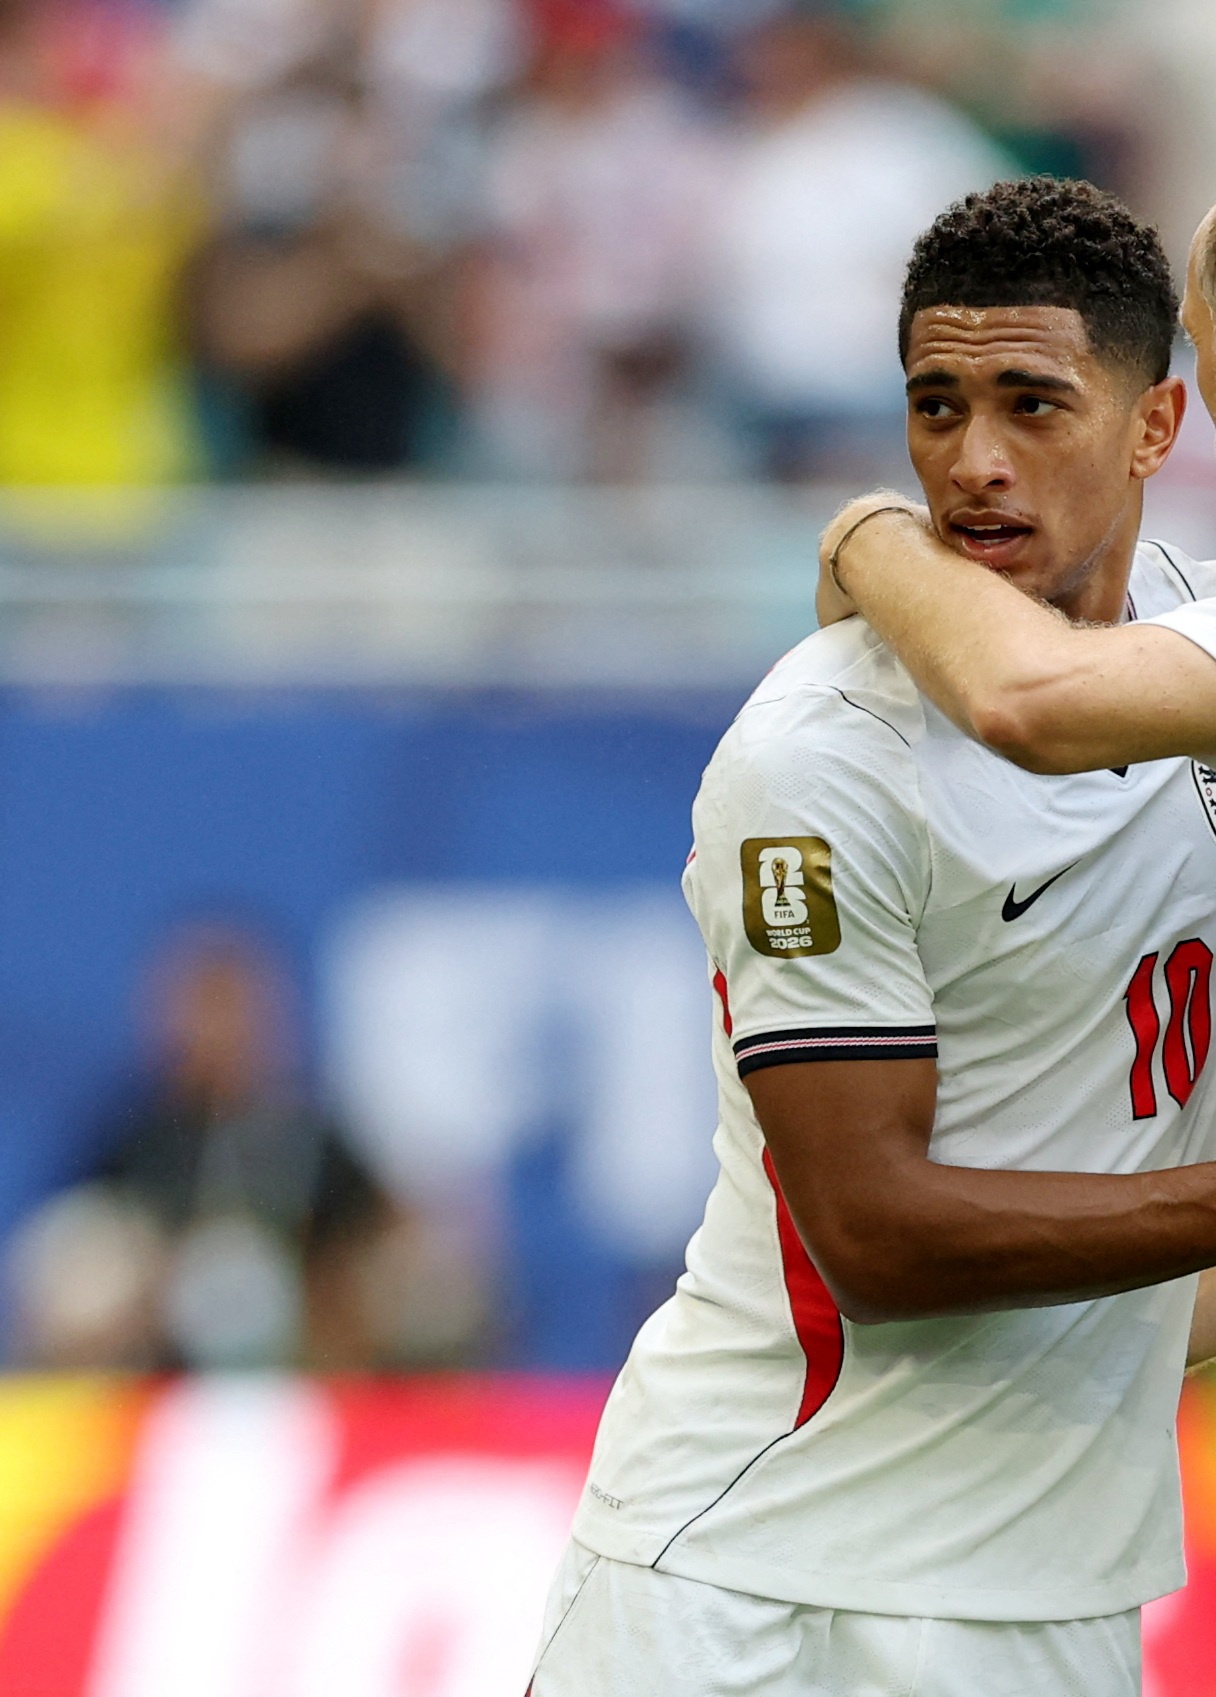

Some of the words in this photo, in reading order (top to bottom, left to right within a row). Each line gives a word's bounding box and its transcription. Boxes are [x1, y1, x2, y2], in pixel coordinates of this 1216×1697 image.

[774, 910, 795, 919] FIFA
[766, 928, 793, 937] WORLD
[793, 927, 811, 936] CUP
[769, 935, 813, 950] 2026
[1122, 937, 1214, 1121] 10
